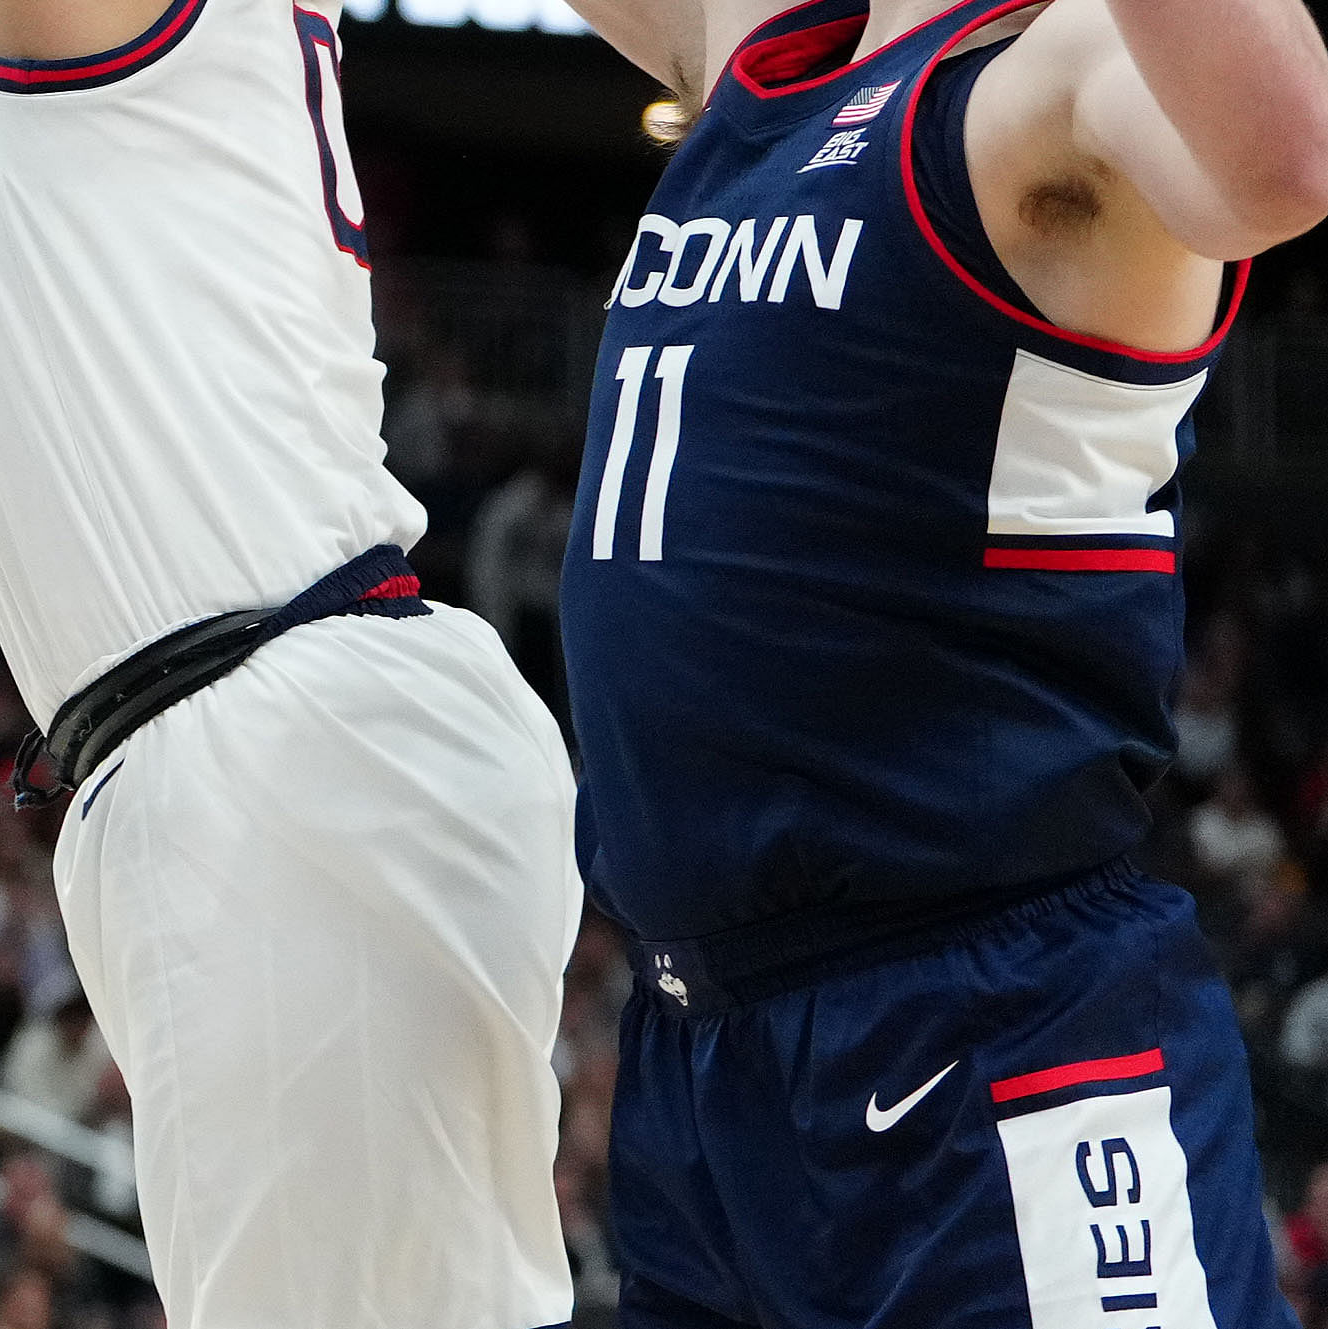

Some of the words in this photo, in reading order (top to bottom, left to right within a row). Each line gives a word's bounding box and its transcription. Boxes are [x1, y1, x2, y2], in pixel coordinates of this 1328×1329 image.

[807, 141, 870, 164] EAST
[822, 127, 868, 149] BIG
[603, 213, 864, 311] CONN
[592, 344, 695, 561] 11
[1074, 1136, 1160, 1329] IES
